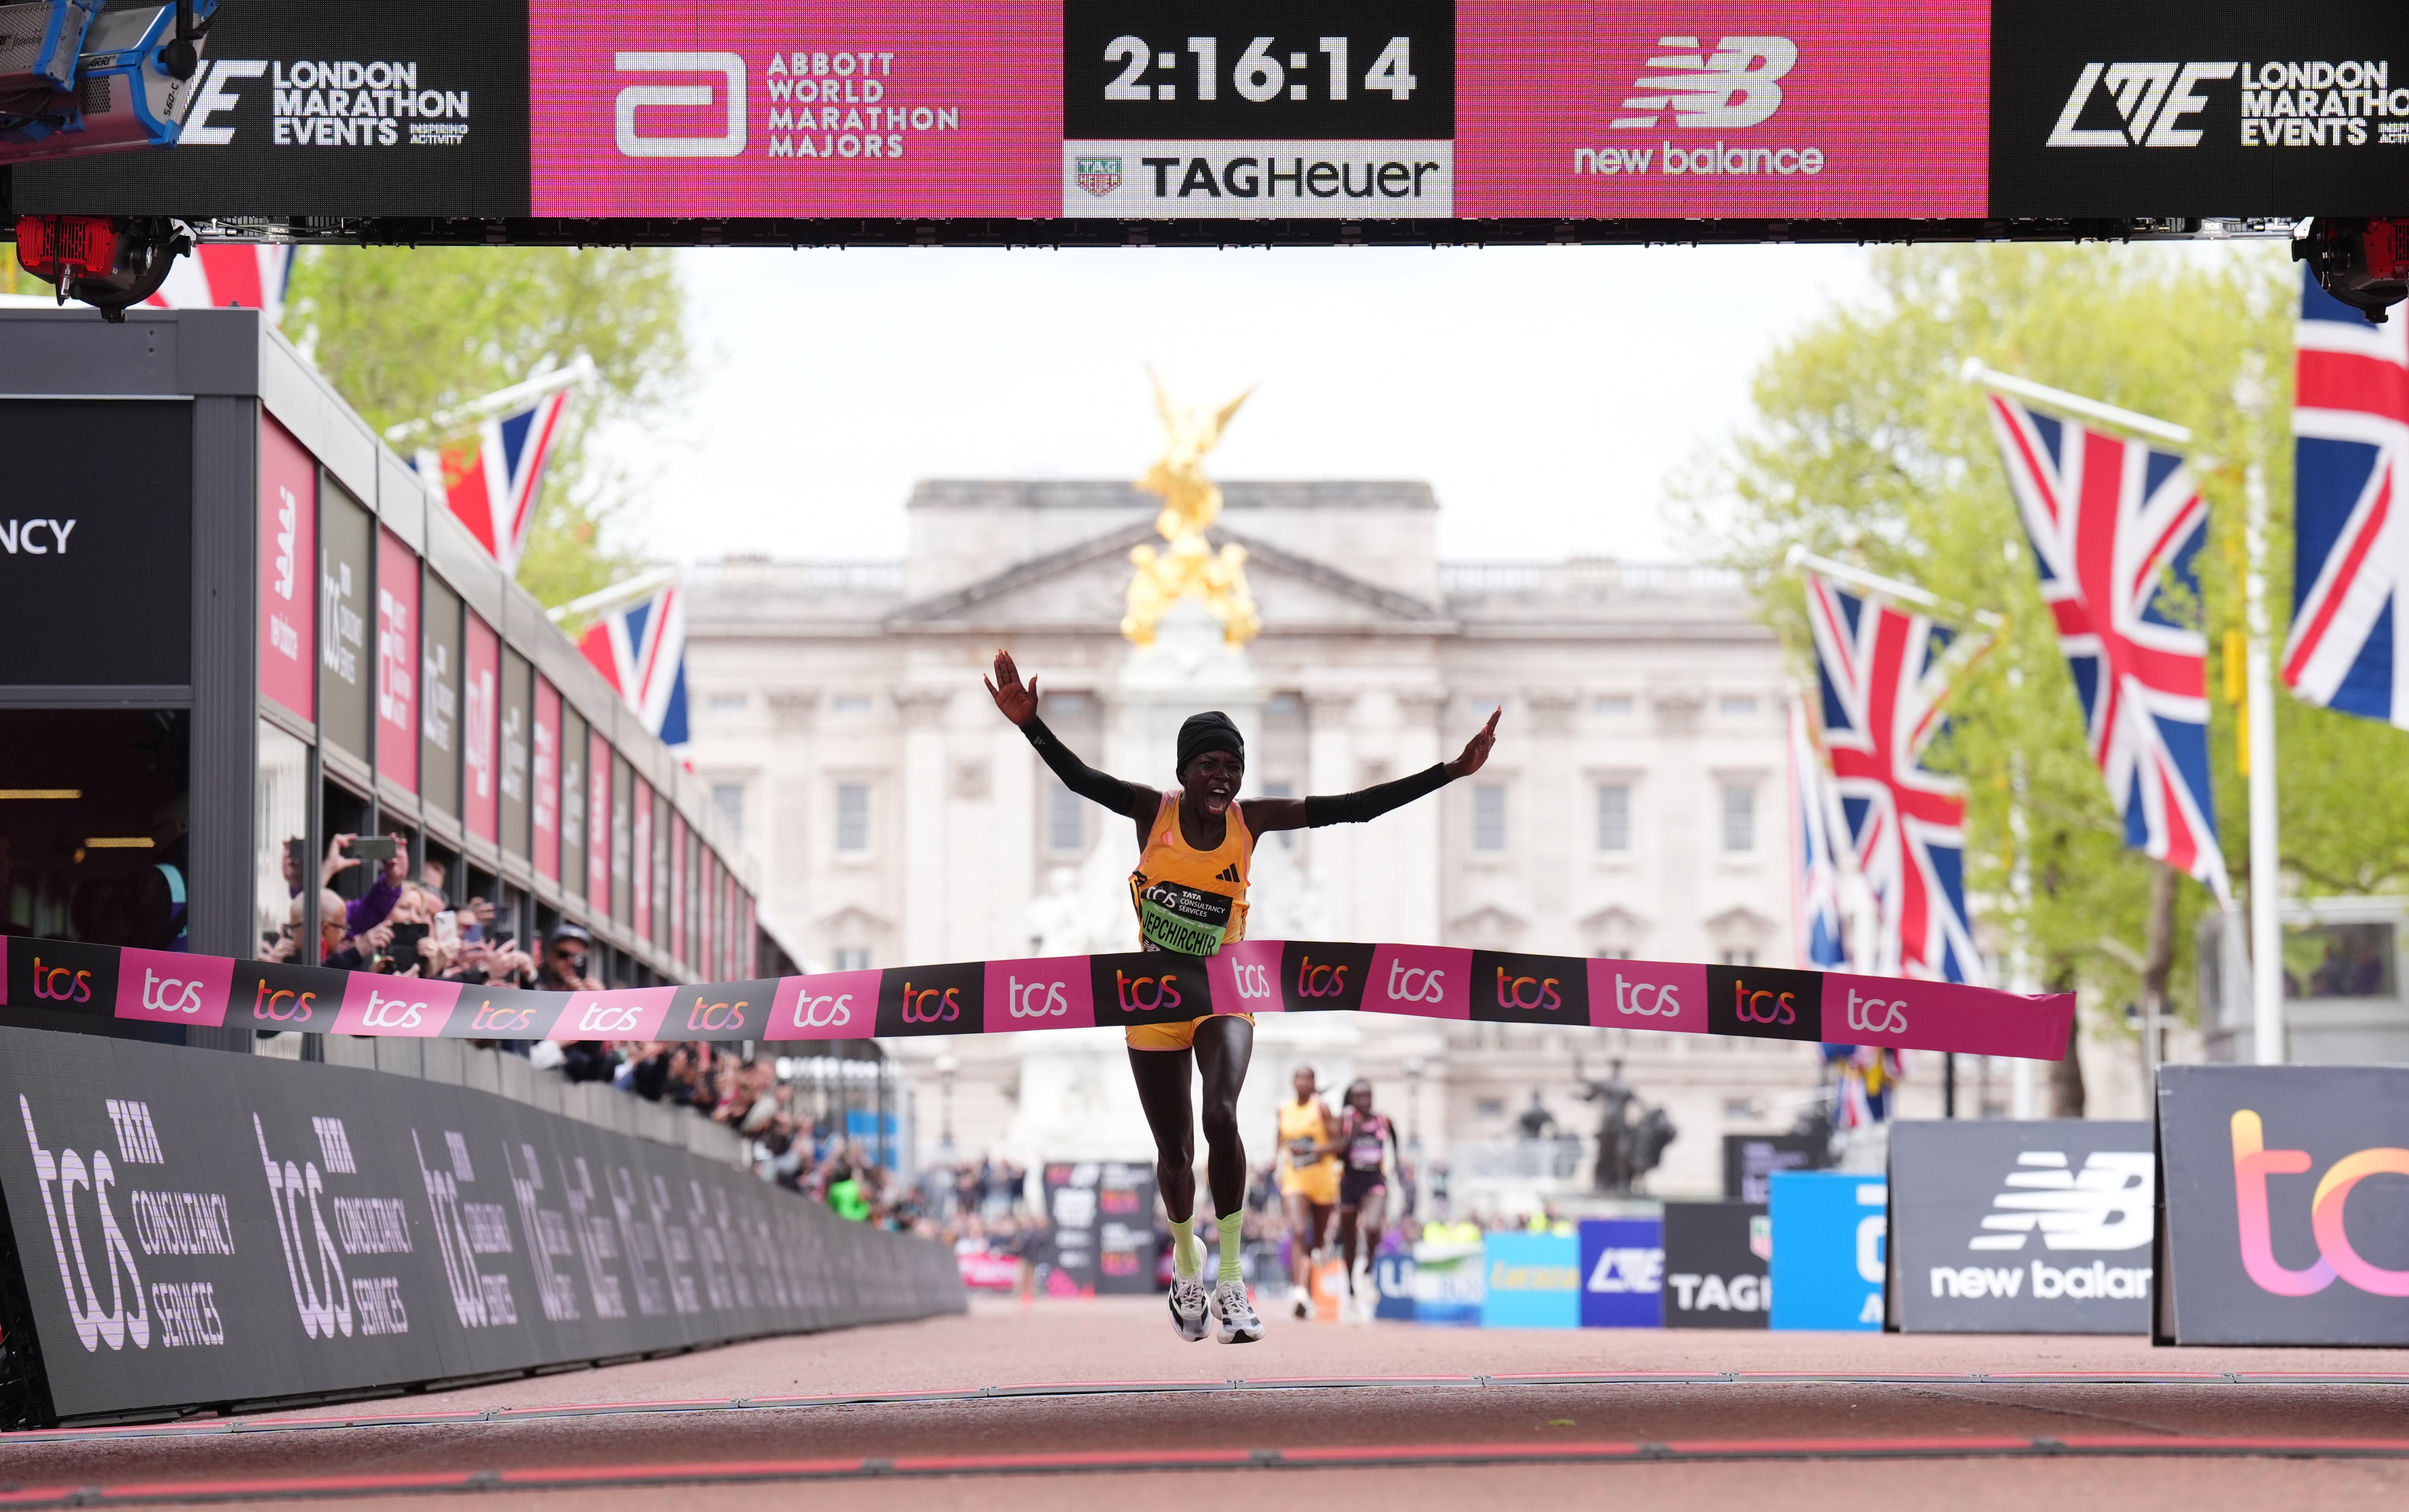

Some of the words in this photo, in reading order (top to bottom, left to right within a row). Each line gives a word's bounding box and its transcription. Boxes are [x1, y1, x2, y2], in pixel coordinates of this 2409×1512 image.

[87, 56, 112, 67] ARRI
[273, 60, 417, 89] LONDON
[767, 52, 894, 76] ABBOTT
[1104, 35, 1417, 102] 2:16:14
[2241, 60, 2388, 89] LONDON
[163, 82, 179, 117] S60-C
[273, 89, 469, 117] MARATHON
[767, 80, 884, 103] WORLD
[273, 117, 398, 145] EVENTS
[769, 107, 960, 131] MARATHON
[2241, 117, 2367, 146] EVENTS
[769, 134, 903, 158] MAJORS
[1574, 147, 1654, 174] new
[1663, 141, 1825, 174] balance
[1178, 905, 1207, 917] SERVICES
[1180, 898, 1225, 914] CONSULTANCY
[1182, 891, 1201, 901] TATA
[1143, 910, 1216, 955] JEPCHIRCHIR
[34, 958, 91, 1002] tcs
[143, 968, 203, 1013] tcs
[1117, 970, 1181, 1011] tcs
[1232, 957, 1270, 999] tcs
[1298, 956, 1348, 997] tcs
[1387, 958, 1444, 1003] tcs
[1497, 967, 1561, 1010] tcs
[1616, 974, 1680, 1017] tcs
[253, 979, 316, 1022] tcs
[363, 990, 427, 1028] tcs
[471, 1000, 537, 1030] tcs
[687, 997, 749, 1030] tcs
[793, 990, 853, 1027] tcs
[902, 982, 959, 1023] tcs
[1010, 976, 1067, 1018] tcs
[1736, 980, 1795, 1025] tcs
[1848, 988, 1907, 1033] tcs
[578, 1002, 643, 1031] tcs
[105, 1099, 164, 1164] TATA
[19, 1093, 150, 1352] tcs
[131, 1190, 235, 1255] CONSULTANCY
[253, 1111, 353, 1339] tcs
[1930, 1266, 2025, 1299] new
[152, 1282, 223, 1347] SERVICES
